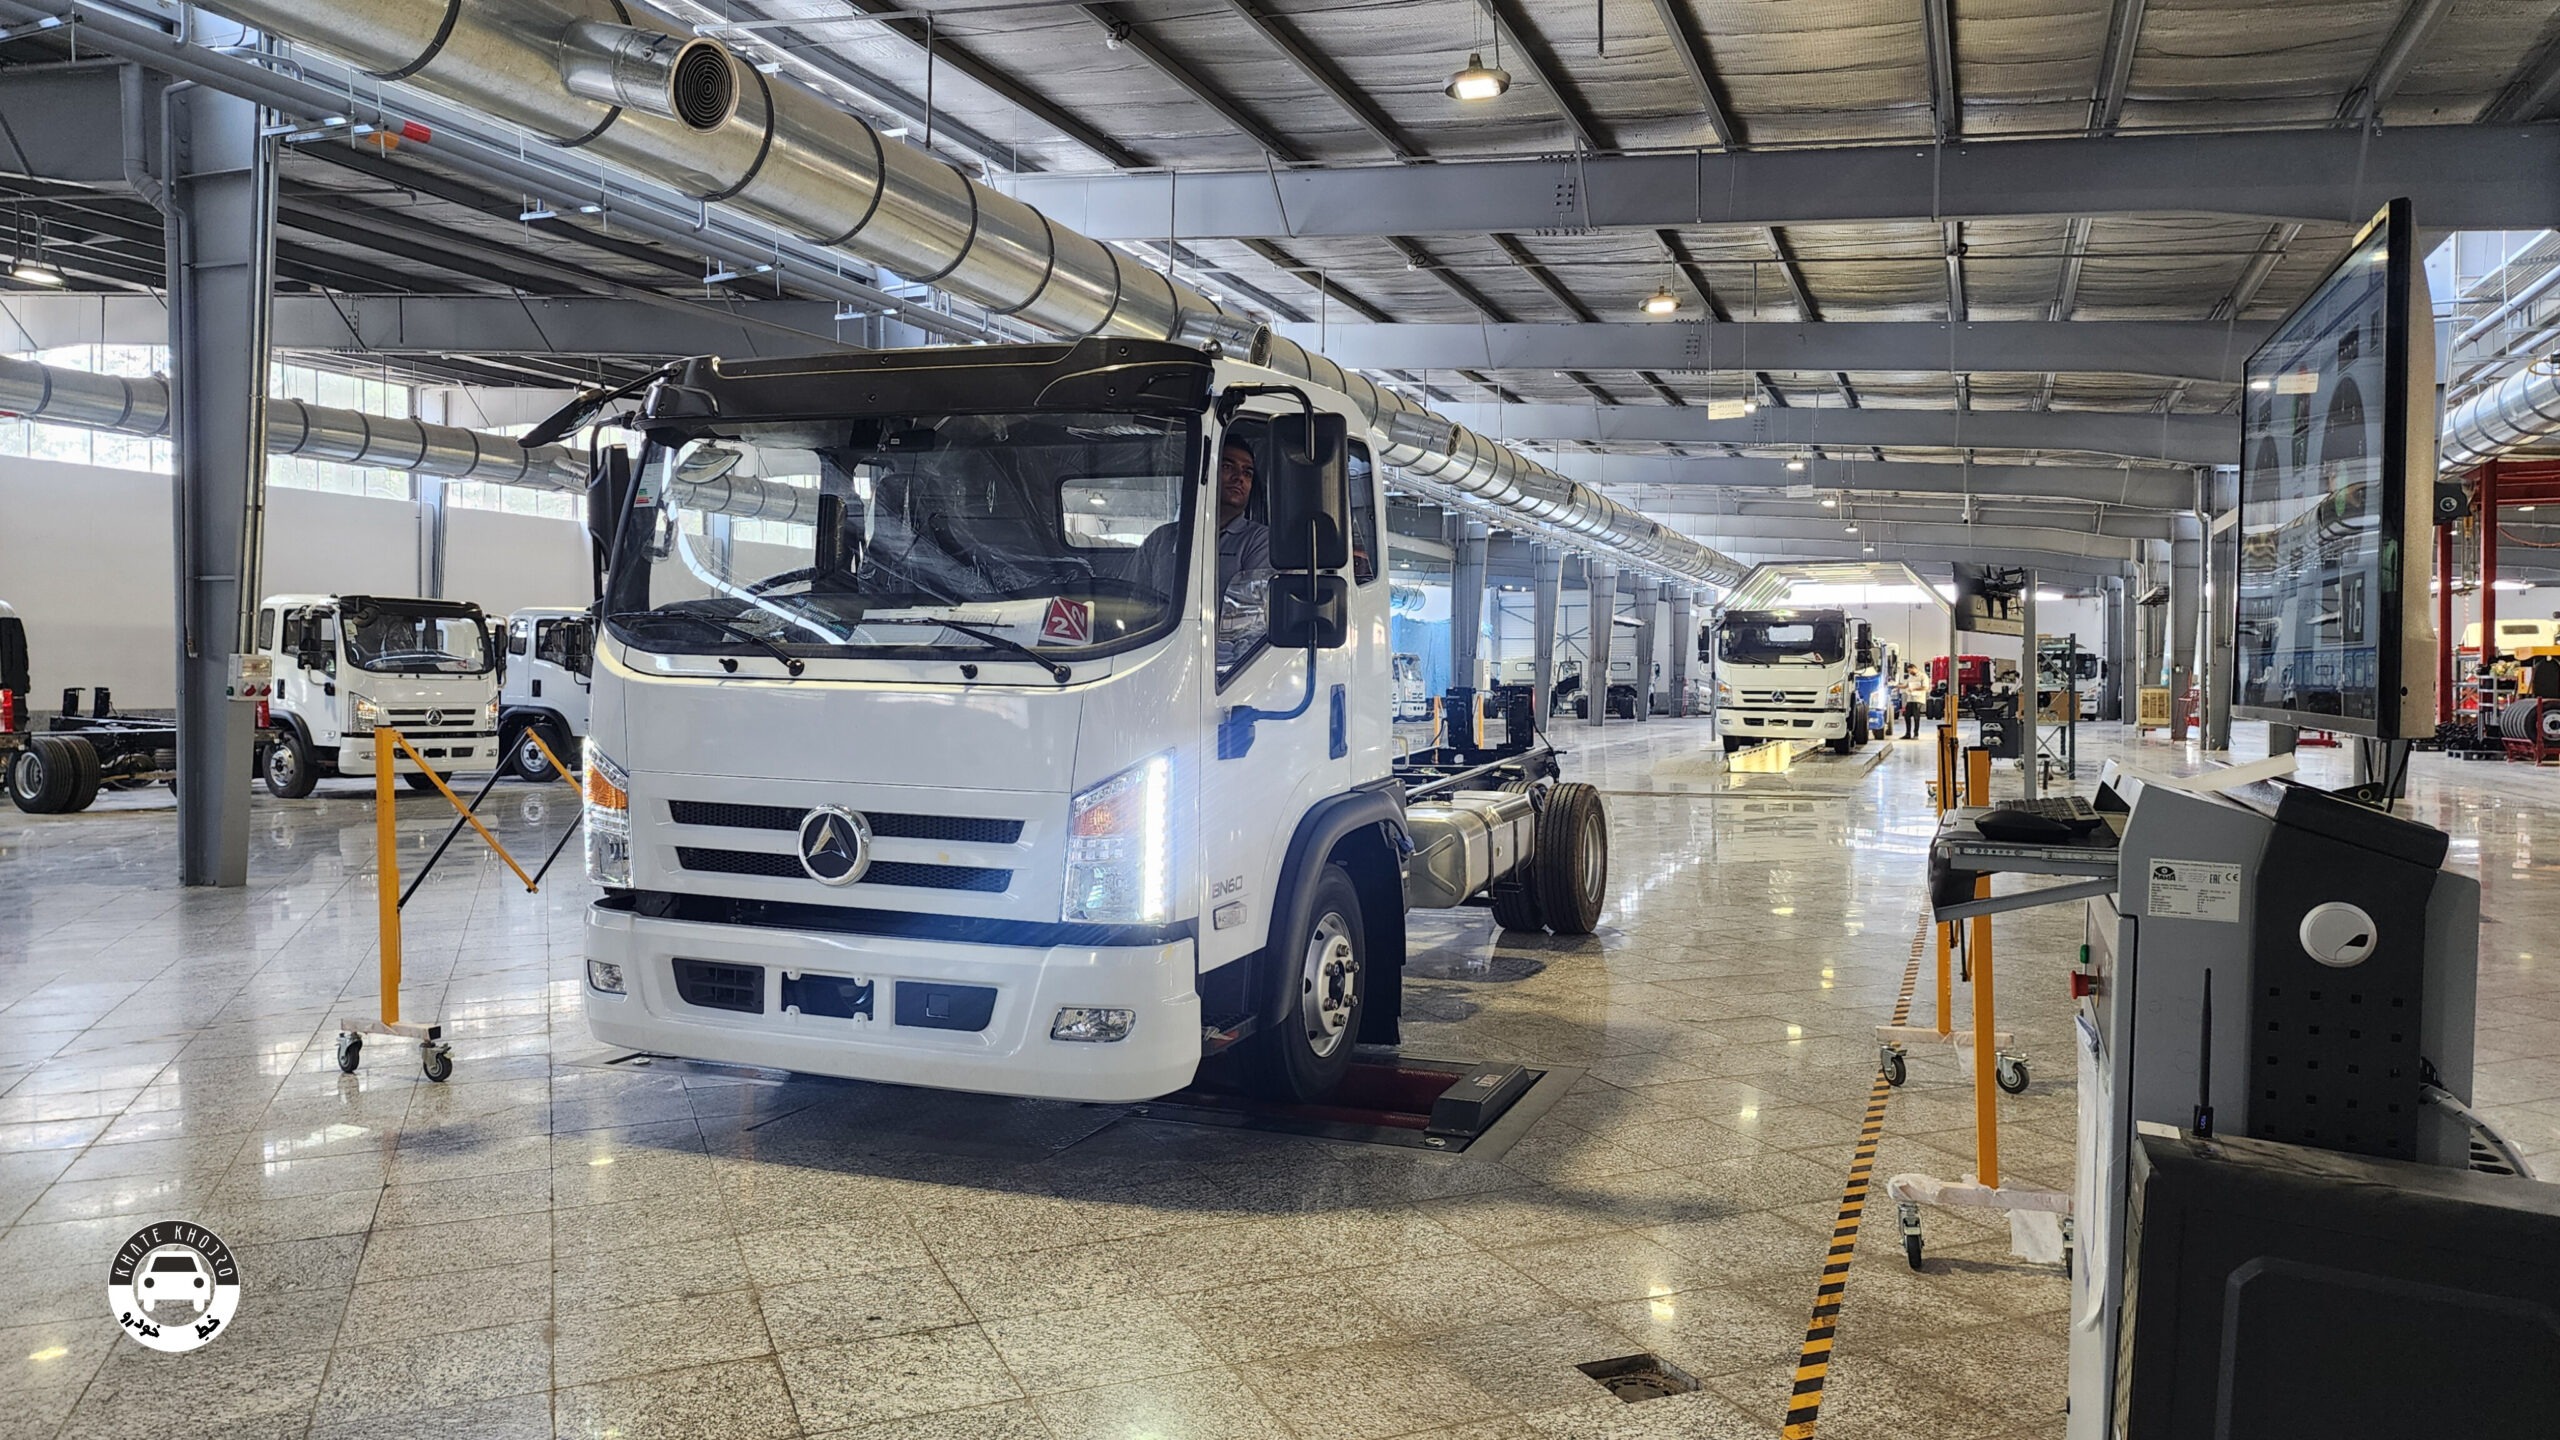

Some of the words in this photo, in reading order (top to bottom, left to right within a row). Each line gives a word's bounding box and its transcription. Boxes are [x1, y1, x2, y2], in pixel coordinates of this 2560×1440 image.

[1051, 616, 1071, 635] 2
[2152, 872, 2176, 881] MAHA
[1212, 875, 1243, 899] BN60
